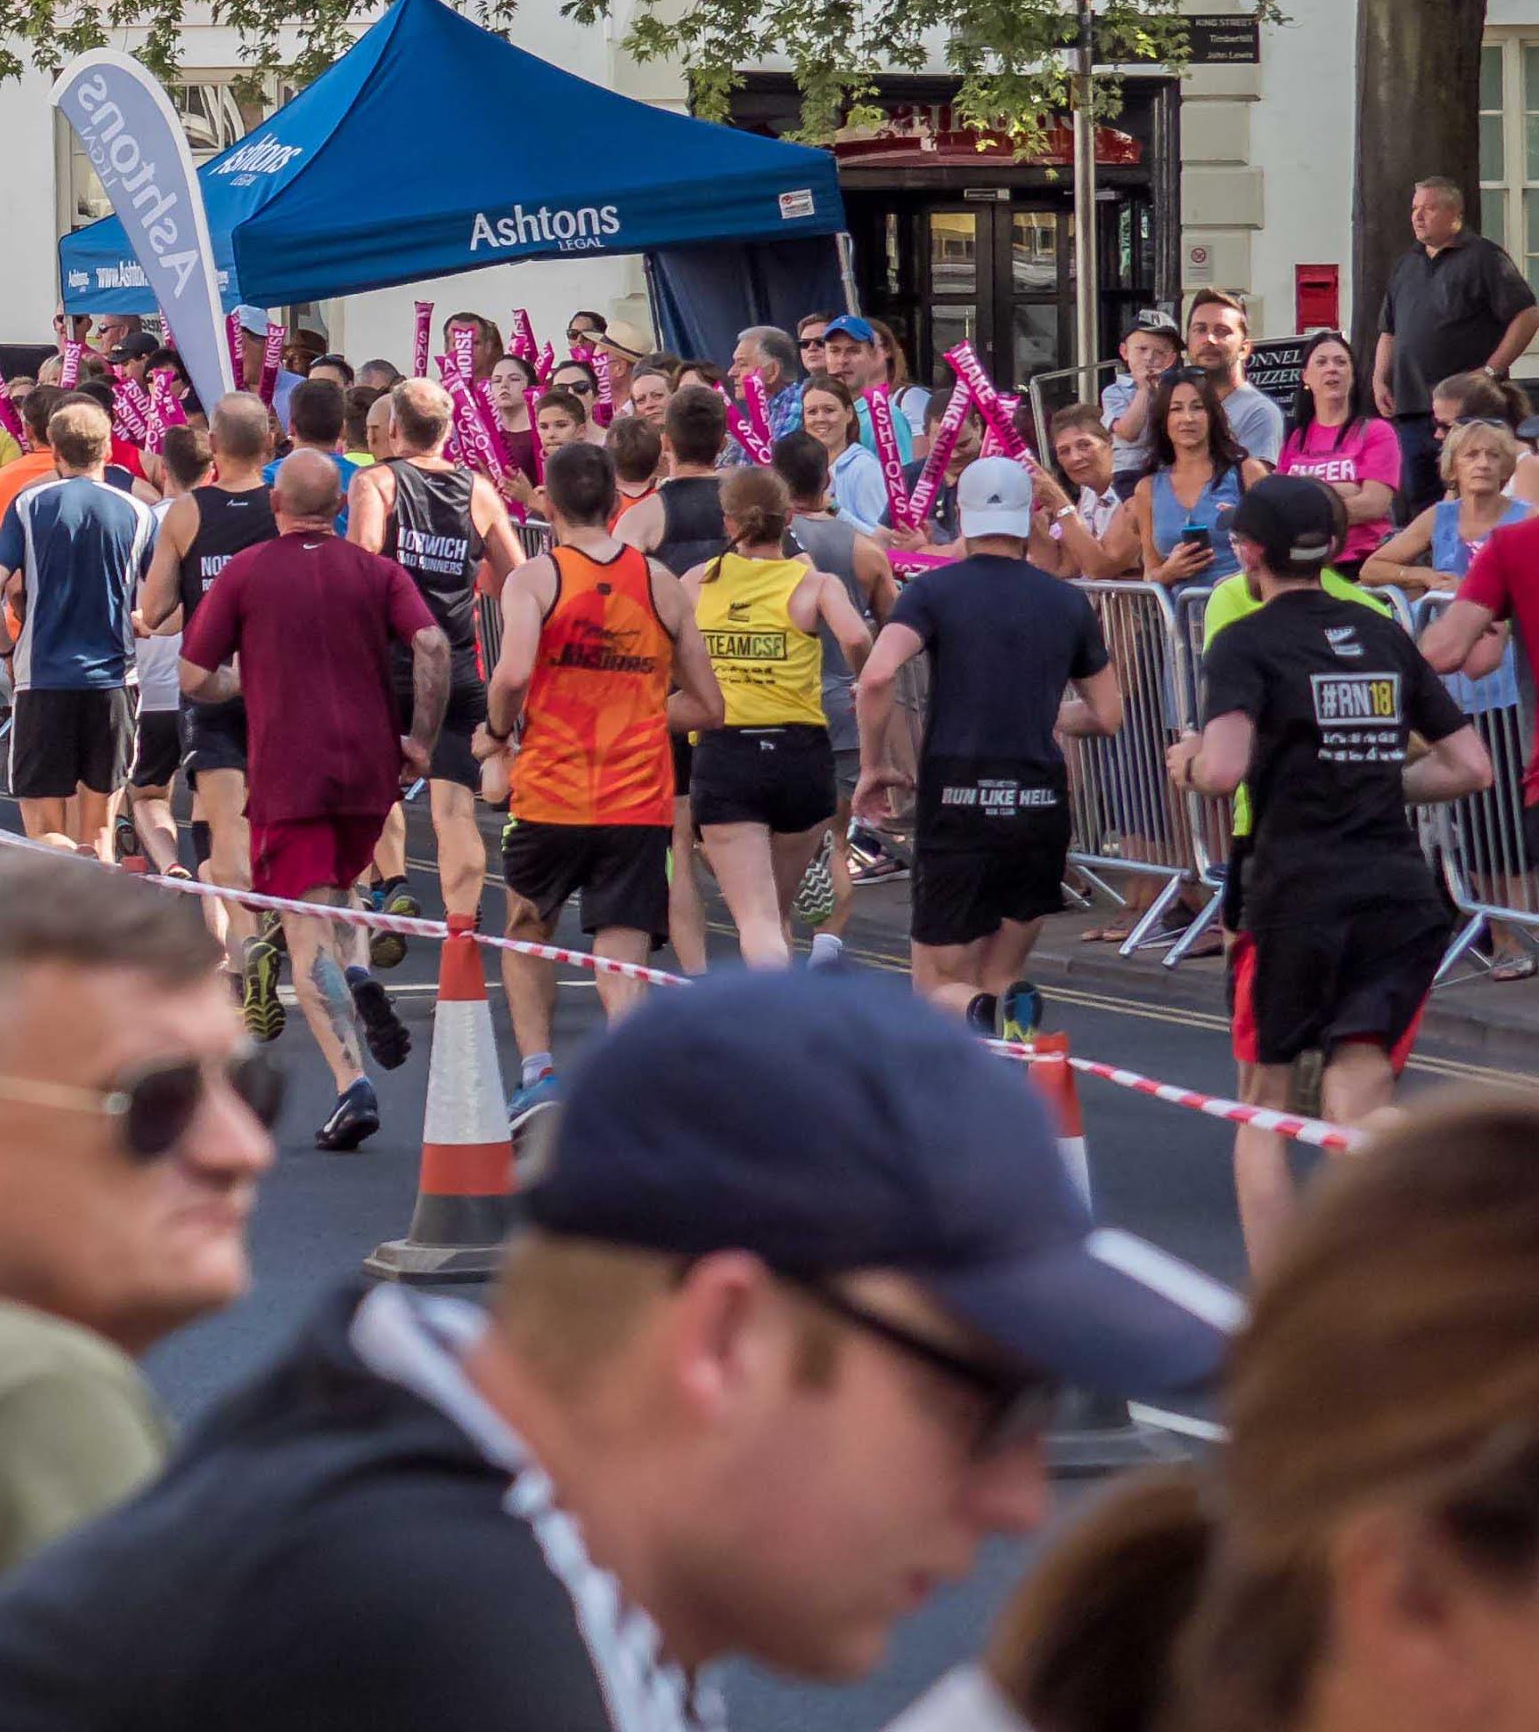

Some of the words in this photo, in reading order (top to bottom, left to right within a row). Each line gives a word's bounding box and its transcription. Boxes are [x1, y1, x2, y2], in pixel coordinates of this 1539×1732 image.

[208, 133, 304, 176] Ashtons
[470, 204, 620, 252] Ashtons
[557, 236, 605, 251] LEGAL
[62, 340, 82, 388] NOISE
[268, 326, 286, 369] NOISE
[455, 329, 473, 378] NOISE
[593, 355, 612, 405] NOISE
[952, 344, 997, 405] MAKE
[1247, 371, 1301, 385] PIZZER
[872, 390, 908, 514] ASHTONS
[1322, 680, 1395, 717] #RN18
[942, 788, 977, 804] RUN
[979, 789, 1016, 805] LIKE
[1019, 789, 1057, 805] HELL
